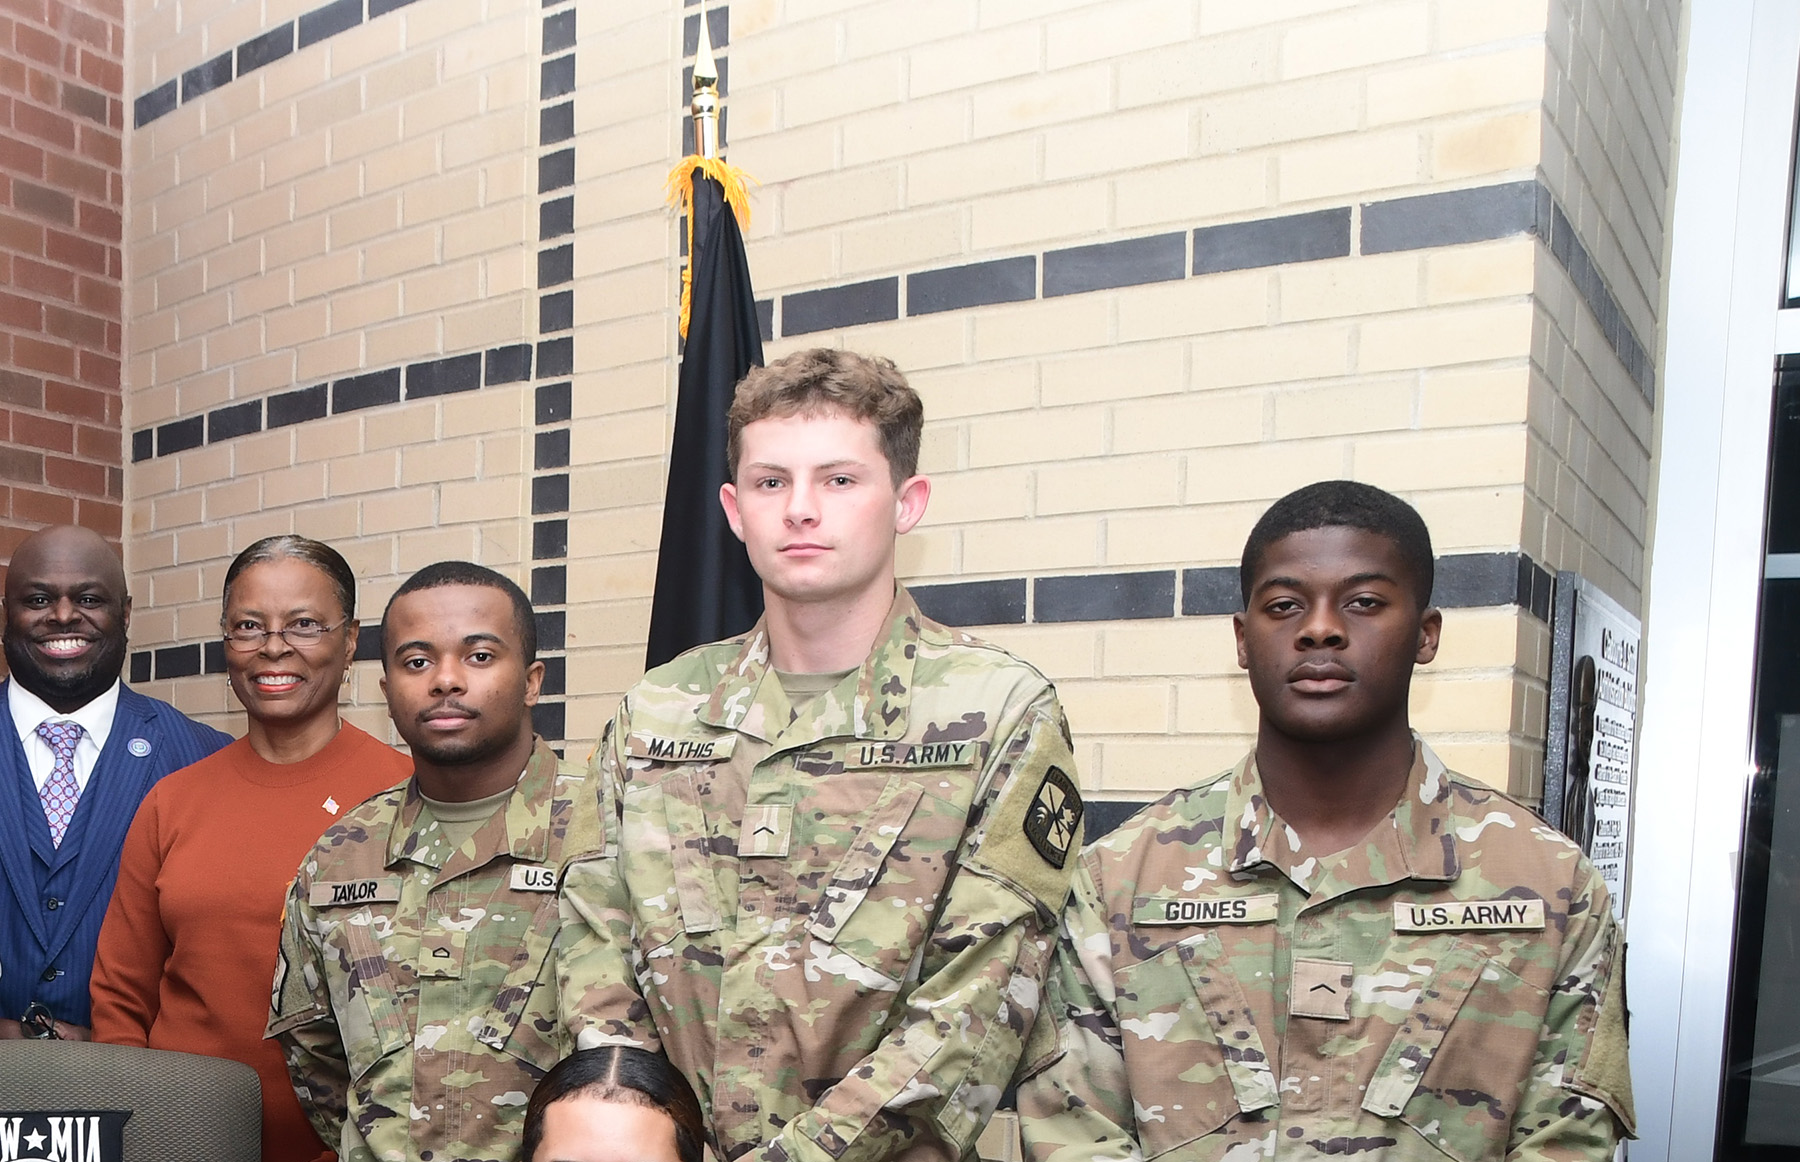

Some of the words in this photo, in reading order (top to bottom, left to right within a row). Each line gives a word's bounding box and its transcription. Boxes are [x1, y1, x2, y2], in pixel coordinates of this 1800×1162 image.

[648, 738, 715, 758] MATHIS
[860, 745, 900, 766] U.S.
[902, 744, 966, 764] ARMY
[524, 869, 557, 887] U.S.
[331, 881, 378, 902] TAYLOR
[1165, 900, 1247, 921] GOINES
[1410, 907, 1454, 927] U.S.
[1460, 904, 1528, 924] ARMY
